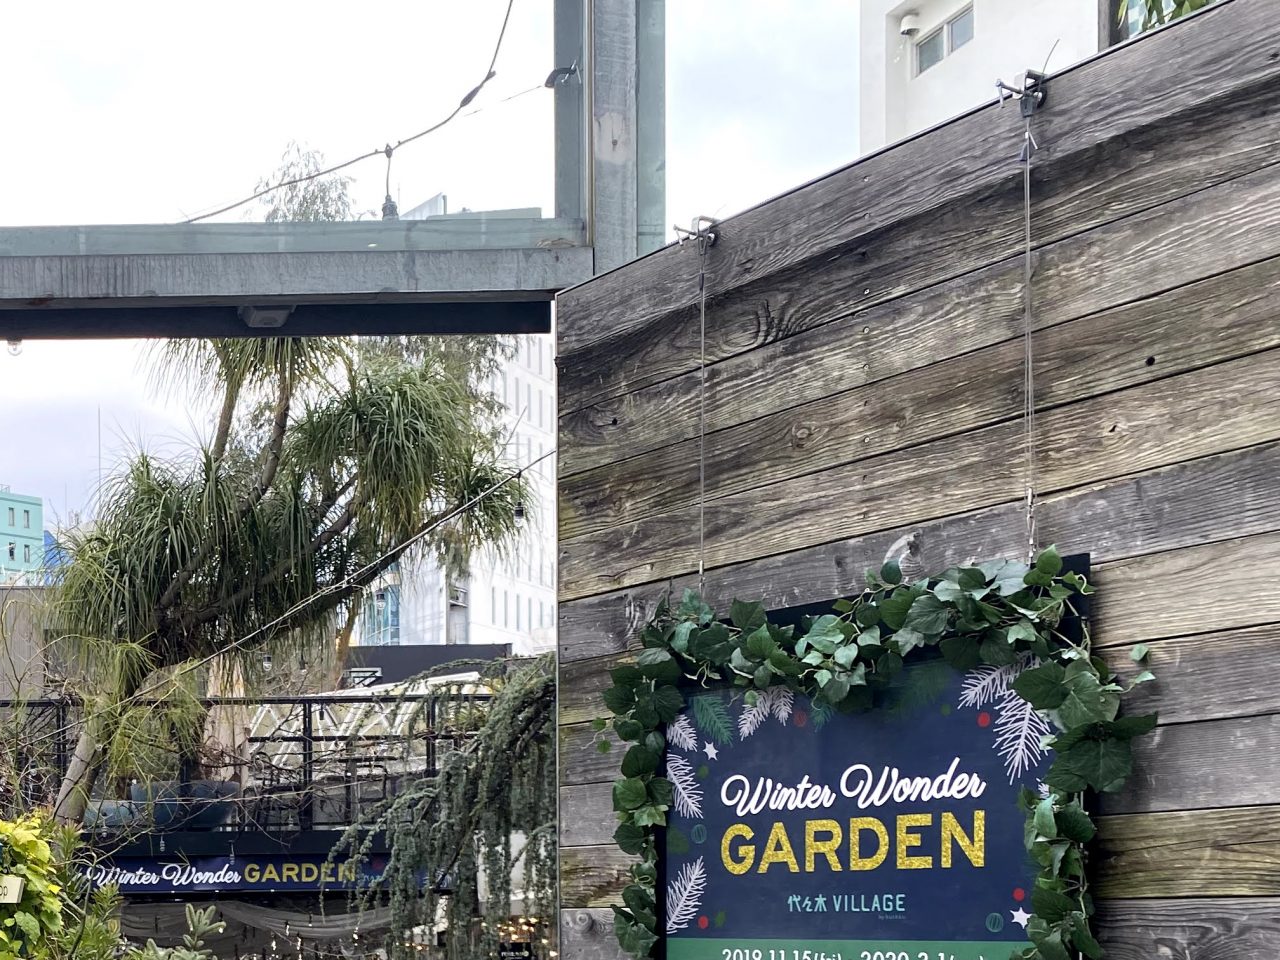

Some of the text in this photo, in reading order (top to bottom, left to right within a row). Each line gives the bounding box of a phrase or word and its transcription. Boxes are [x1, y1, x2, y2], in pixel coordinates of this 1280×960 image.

[720, 756, 988, 817] Winter Wonder
[720, 809, 986, 875] GARDEN
[86, 862, 356, 886] Winter Wonder GARDEN
[787, 893, 906, 912] 代々木 VILLAGE
